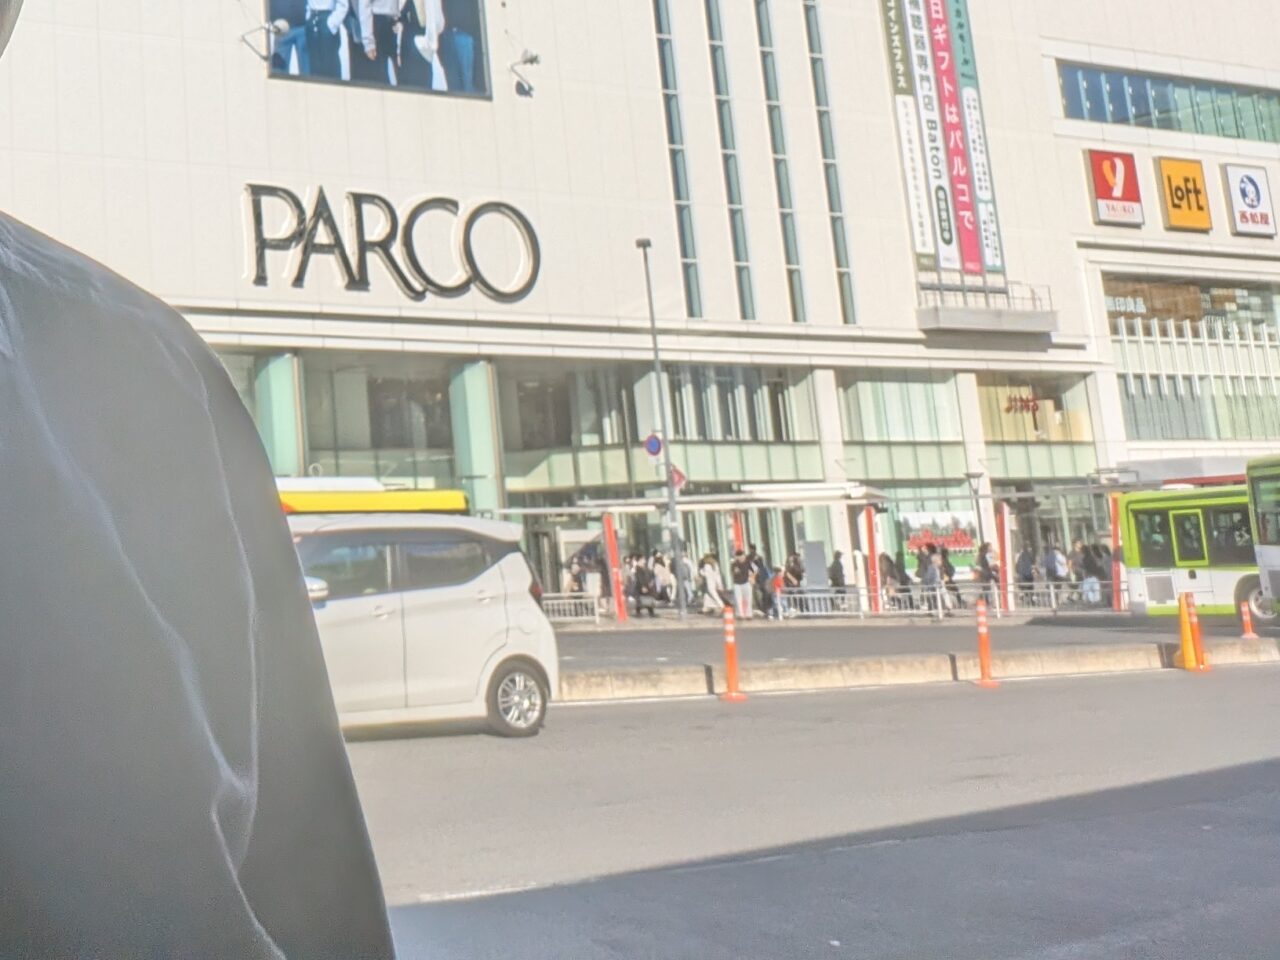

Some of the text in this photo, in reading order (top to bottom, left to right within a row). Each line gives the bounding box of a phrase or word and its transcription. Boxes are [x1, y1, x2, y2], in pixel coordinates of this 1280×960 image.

[924, 118, 945, 180] Baton
[1105, 201, 1135, 214] YAKO
[245, 182, 541, 303] PARCO
